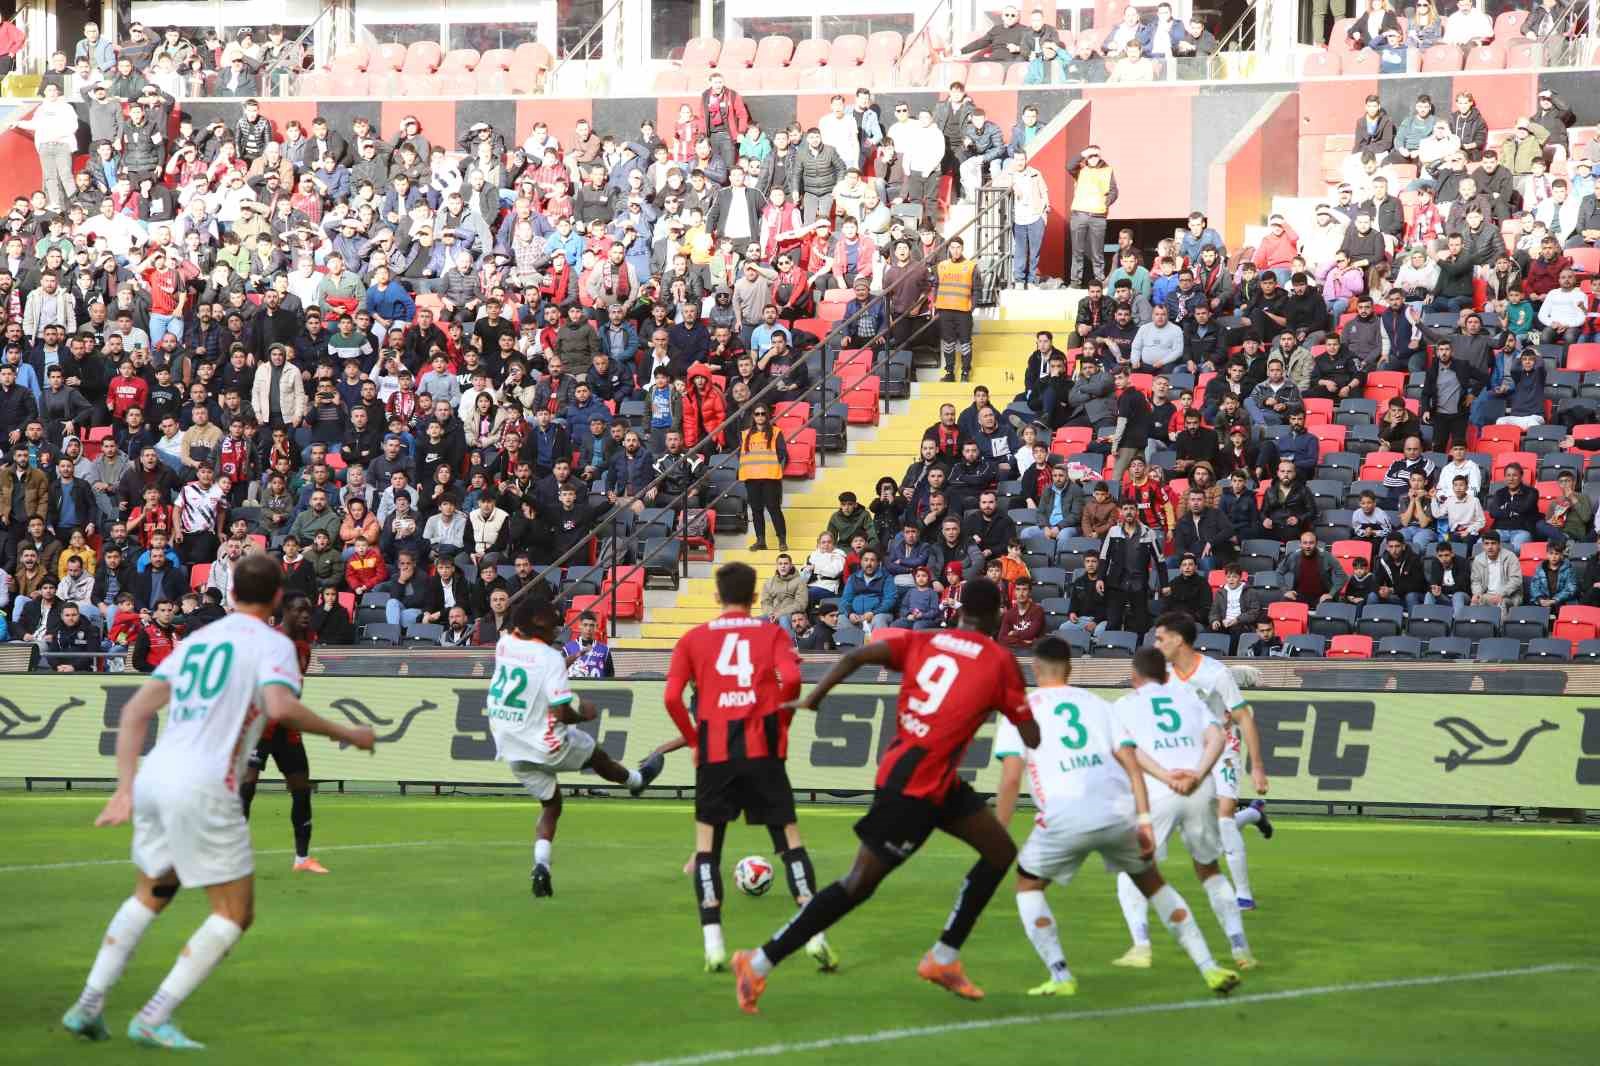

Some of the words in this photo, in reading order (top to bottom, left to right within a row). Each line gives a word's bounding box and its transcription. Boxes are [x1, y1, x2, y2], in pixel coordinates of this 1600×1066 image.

[175, 641, 234, 702] 50
[715, 632, 754, 688] 4
[489, 664, 528, 709] 42
[717, 689, 756, 708] ARDA
[907, 654, 960, 716] 9
[1053, 702, 1088, 750] 3
[1150, 697, 1182, 733] 5
[1059, 754, 1104, 773] LIMA
[1220, 767, 1237, 783] 14
